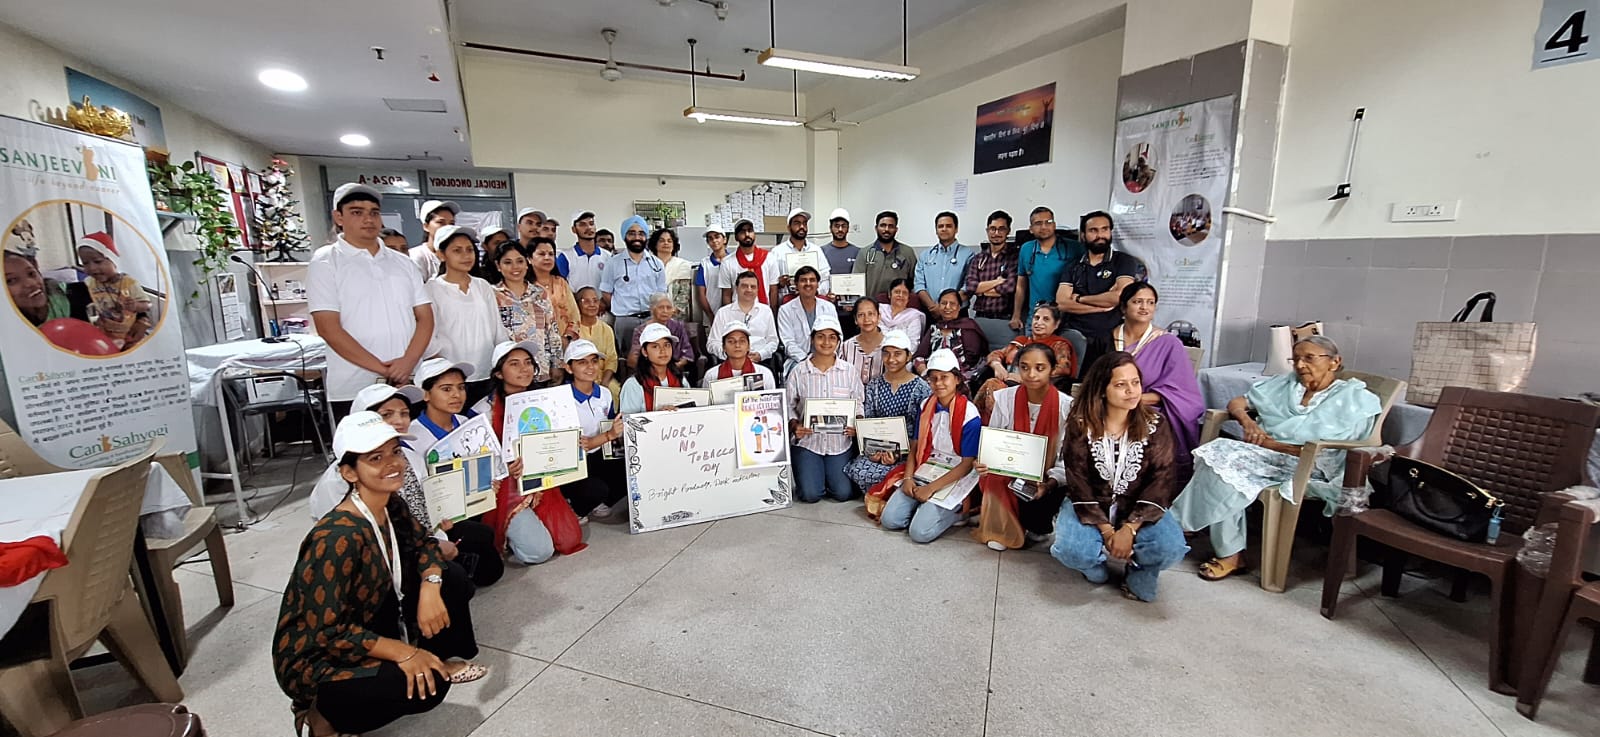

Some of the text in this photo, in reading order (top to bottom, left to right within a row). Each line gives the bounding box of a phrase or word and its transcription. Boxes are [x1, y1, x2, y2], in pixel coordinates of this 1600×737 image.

[1544, 9, 1589, 53] 4
[661, 424, 704, 441] WORLD
[679, 439, 696, 453] NO
